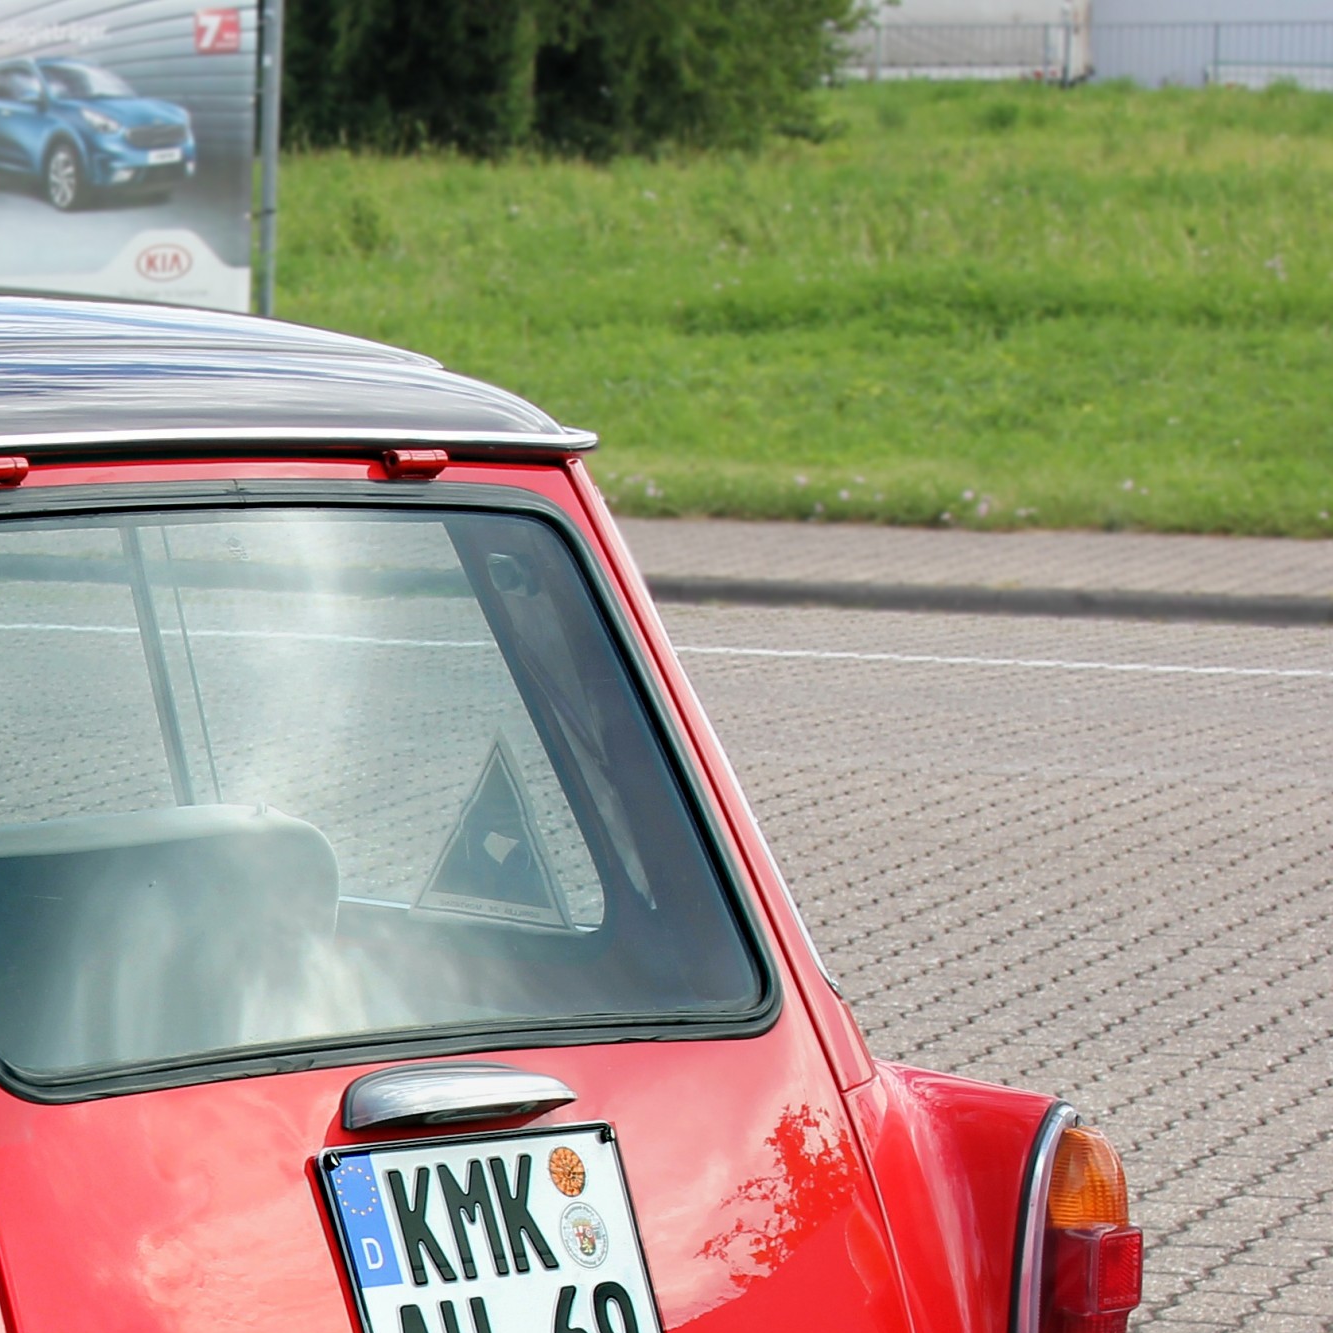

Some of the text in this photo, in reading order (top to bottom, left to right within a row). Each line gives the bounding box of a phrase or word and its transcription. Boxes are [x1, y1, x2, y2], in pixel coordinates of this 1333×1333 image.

[145, 253, 183, 273] KIA
[387, 1154, 559, 1285] KMK
[361, 1237, 384, 1270] D
